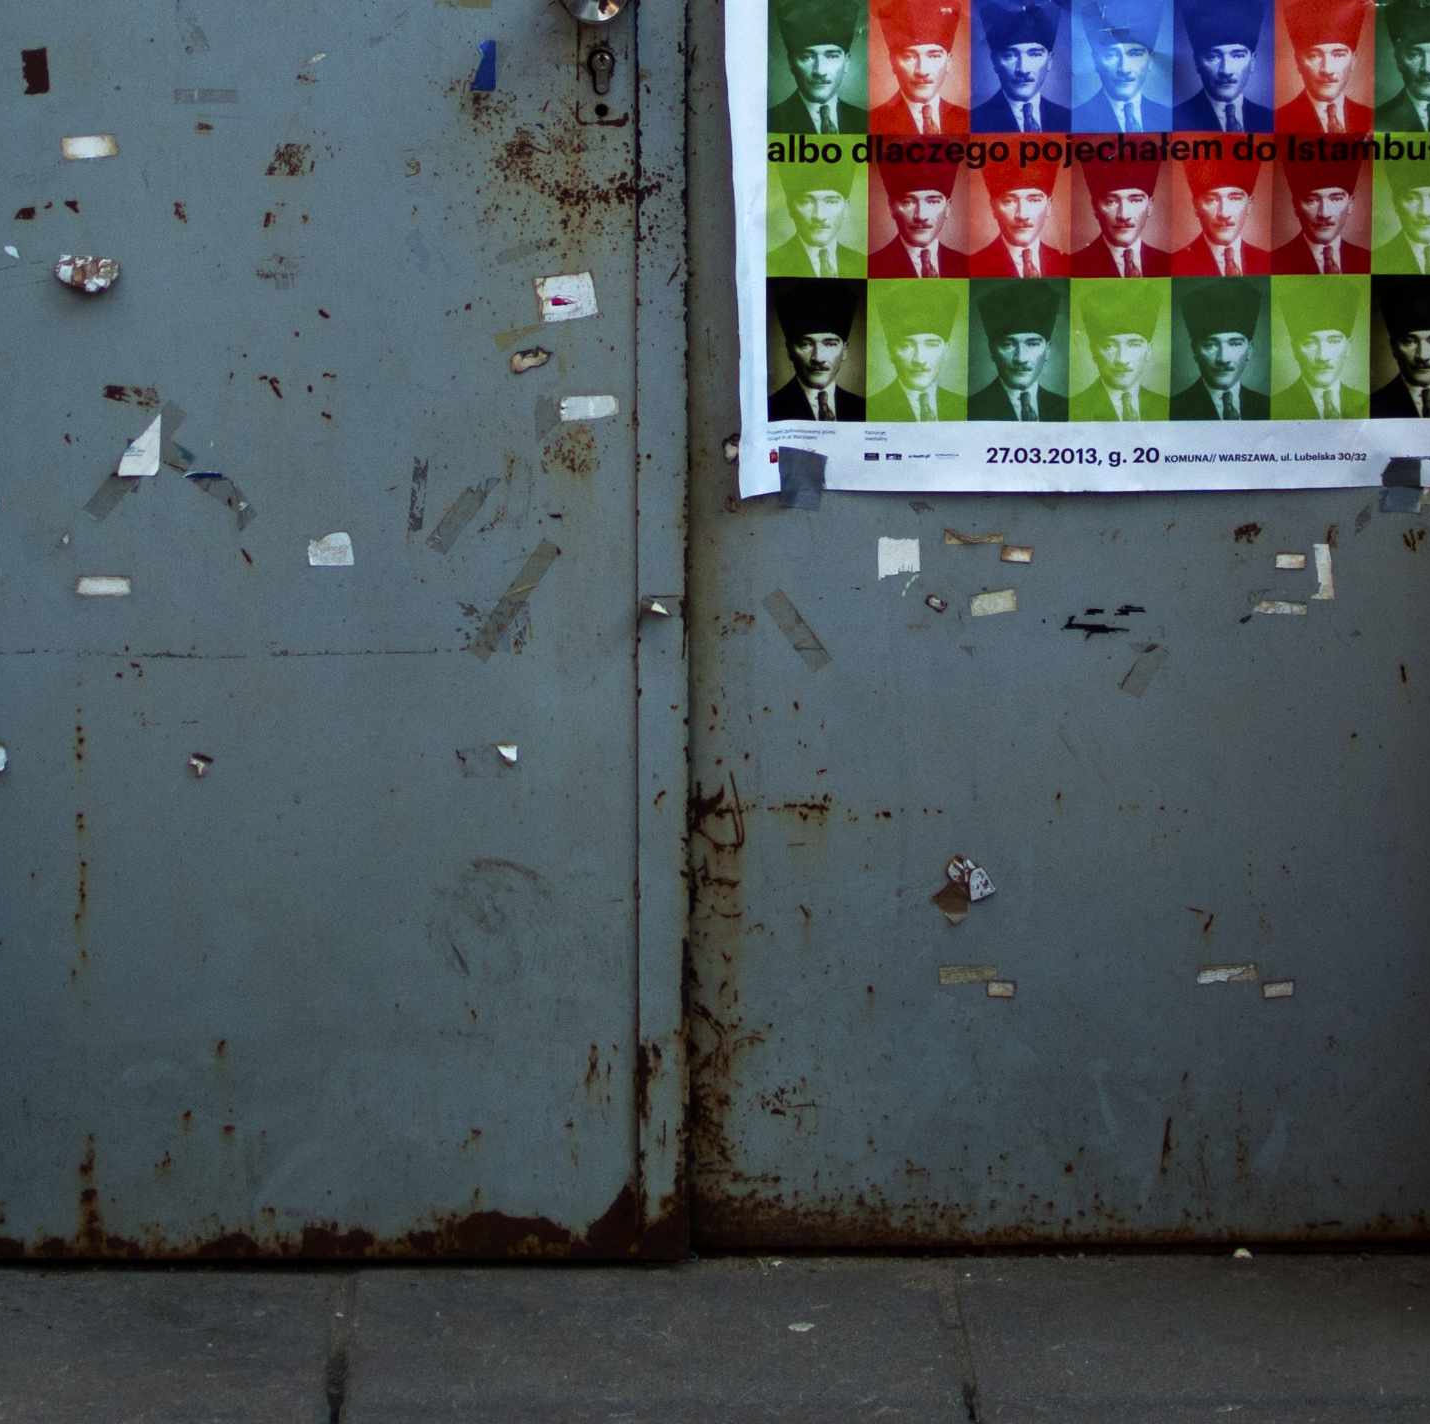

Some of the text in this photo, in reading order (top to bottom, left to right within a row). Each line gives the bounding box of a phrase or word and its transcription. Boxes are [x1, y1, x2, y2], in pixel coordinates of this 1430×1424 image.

[767, 134, 842, 164] albo
[852, 134, 1010, 169] dlaczego
[1019, 132, 1224, 169] pojechałem
[1232, 133, 1278, 162] do
[986, 447, 1103, 466] 27.03.2013,
[1108, 450, 1128, 468] g.
[1132, 447, 1160, 464] 20
[1337, 452, 1367, 462] 30/32
